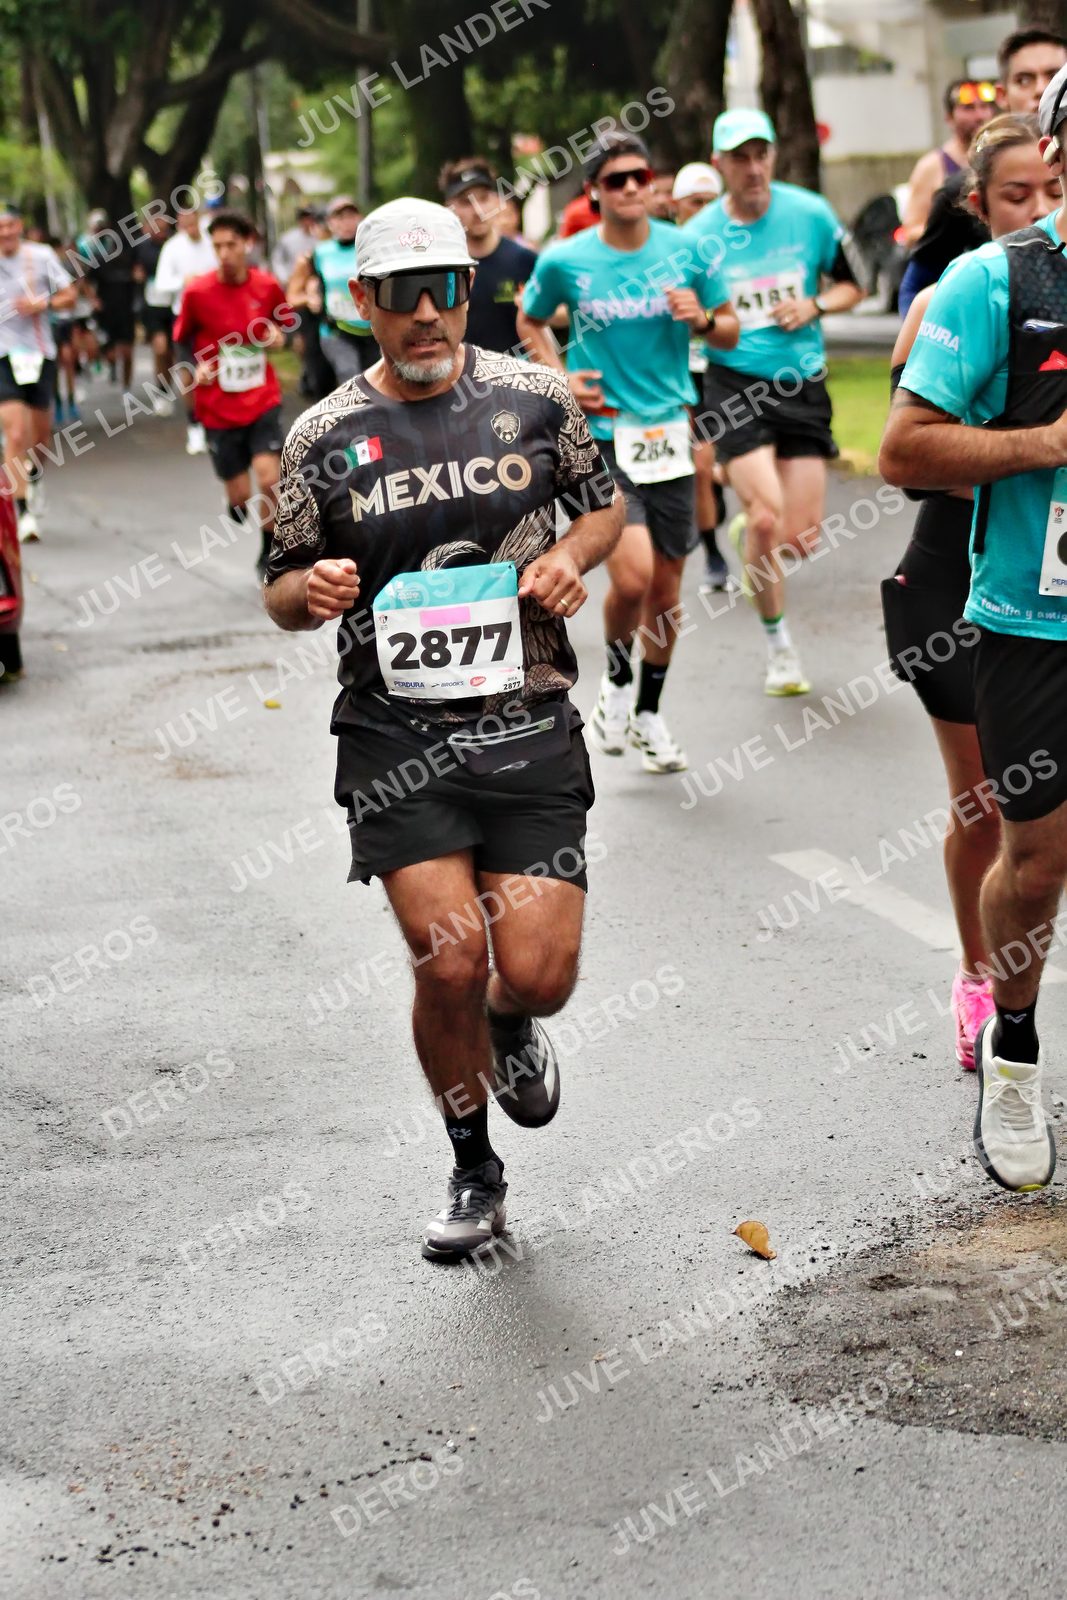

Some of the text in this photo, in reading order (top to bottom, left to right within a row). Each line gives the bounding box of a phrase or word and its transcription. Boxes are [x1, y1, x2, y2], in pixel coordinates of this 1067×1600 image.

[348, 453, 532, 523] MEXICO
[1051, 578, 1067, 586] PER
[1025, 609, 1034, 621] y
[387, 621, 513, 671] 2877
[393, 680, 426, 689] PERDURA
[440, 680, 465, 688] BROOKS
[503, 680, 521, 691] 2877
